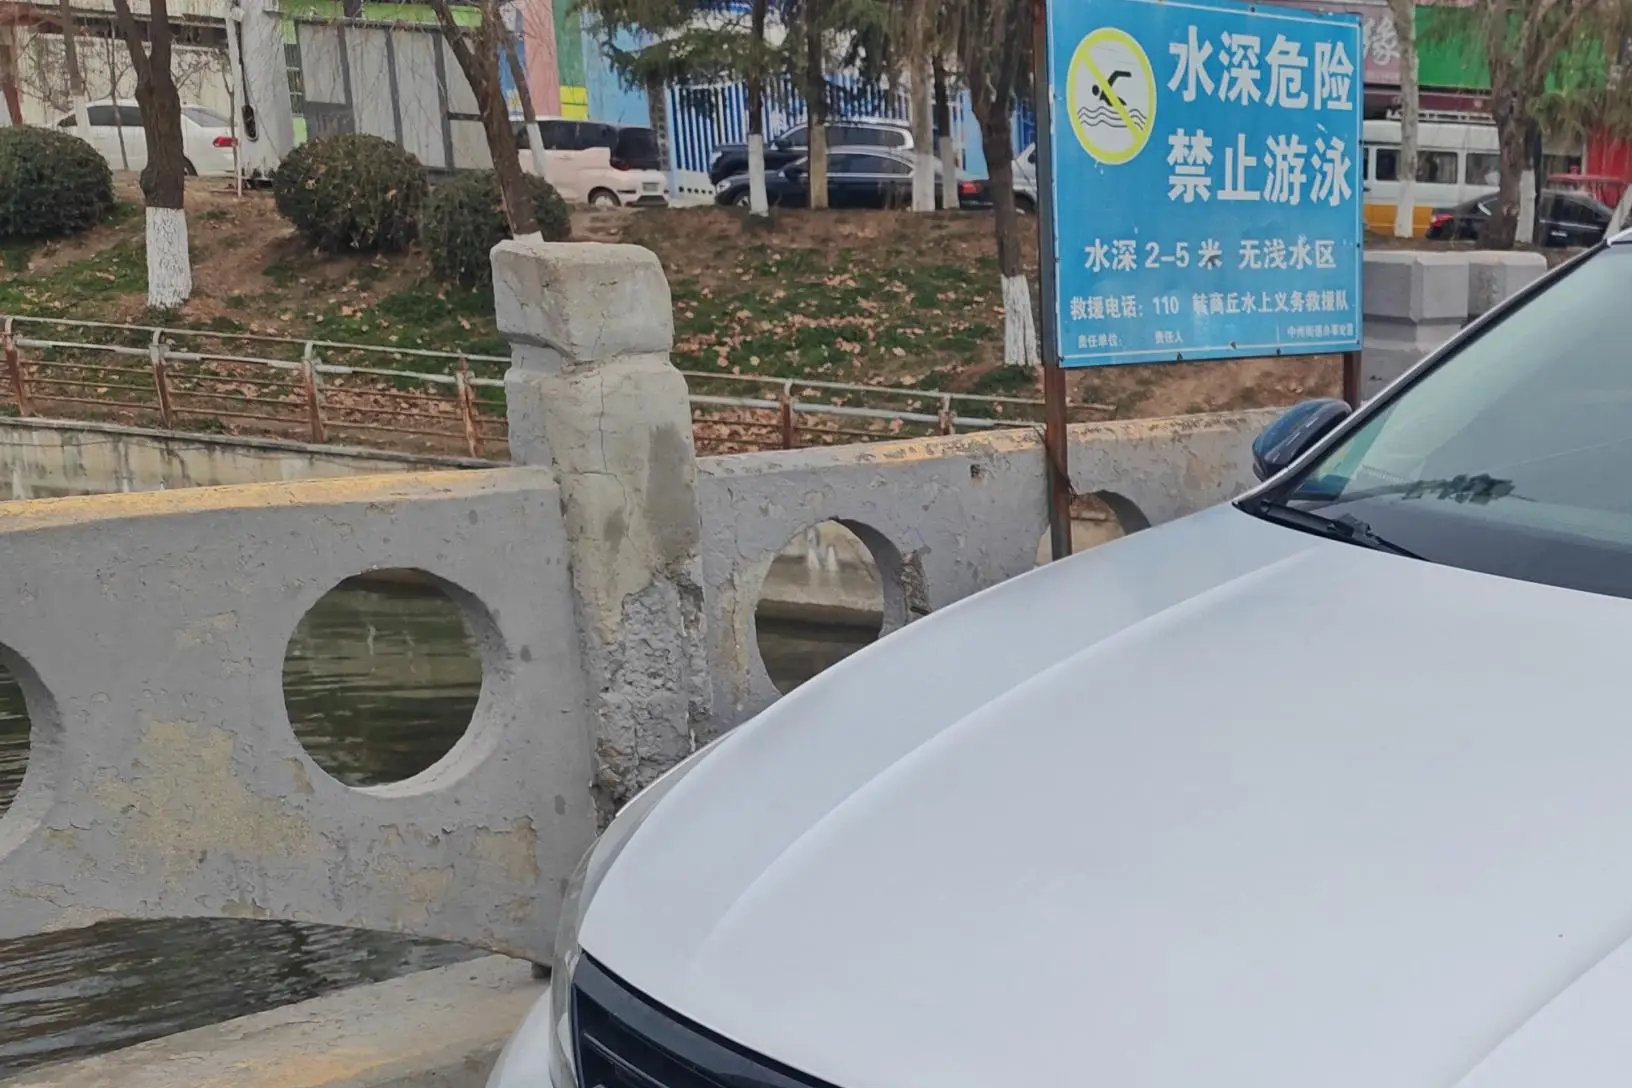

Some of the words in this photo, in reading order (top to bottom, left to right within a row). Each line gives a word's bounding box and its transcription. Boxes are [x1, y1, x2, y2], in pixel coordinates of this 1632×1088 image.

[1167, 25, 1354, 110] 水深危险
[1167, 128, 1352, 206] 禁止游泳
[1238, 236, 1337, 270] 无浅水区
